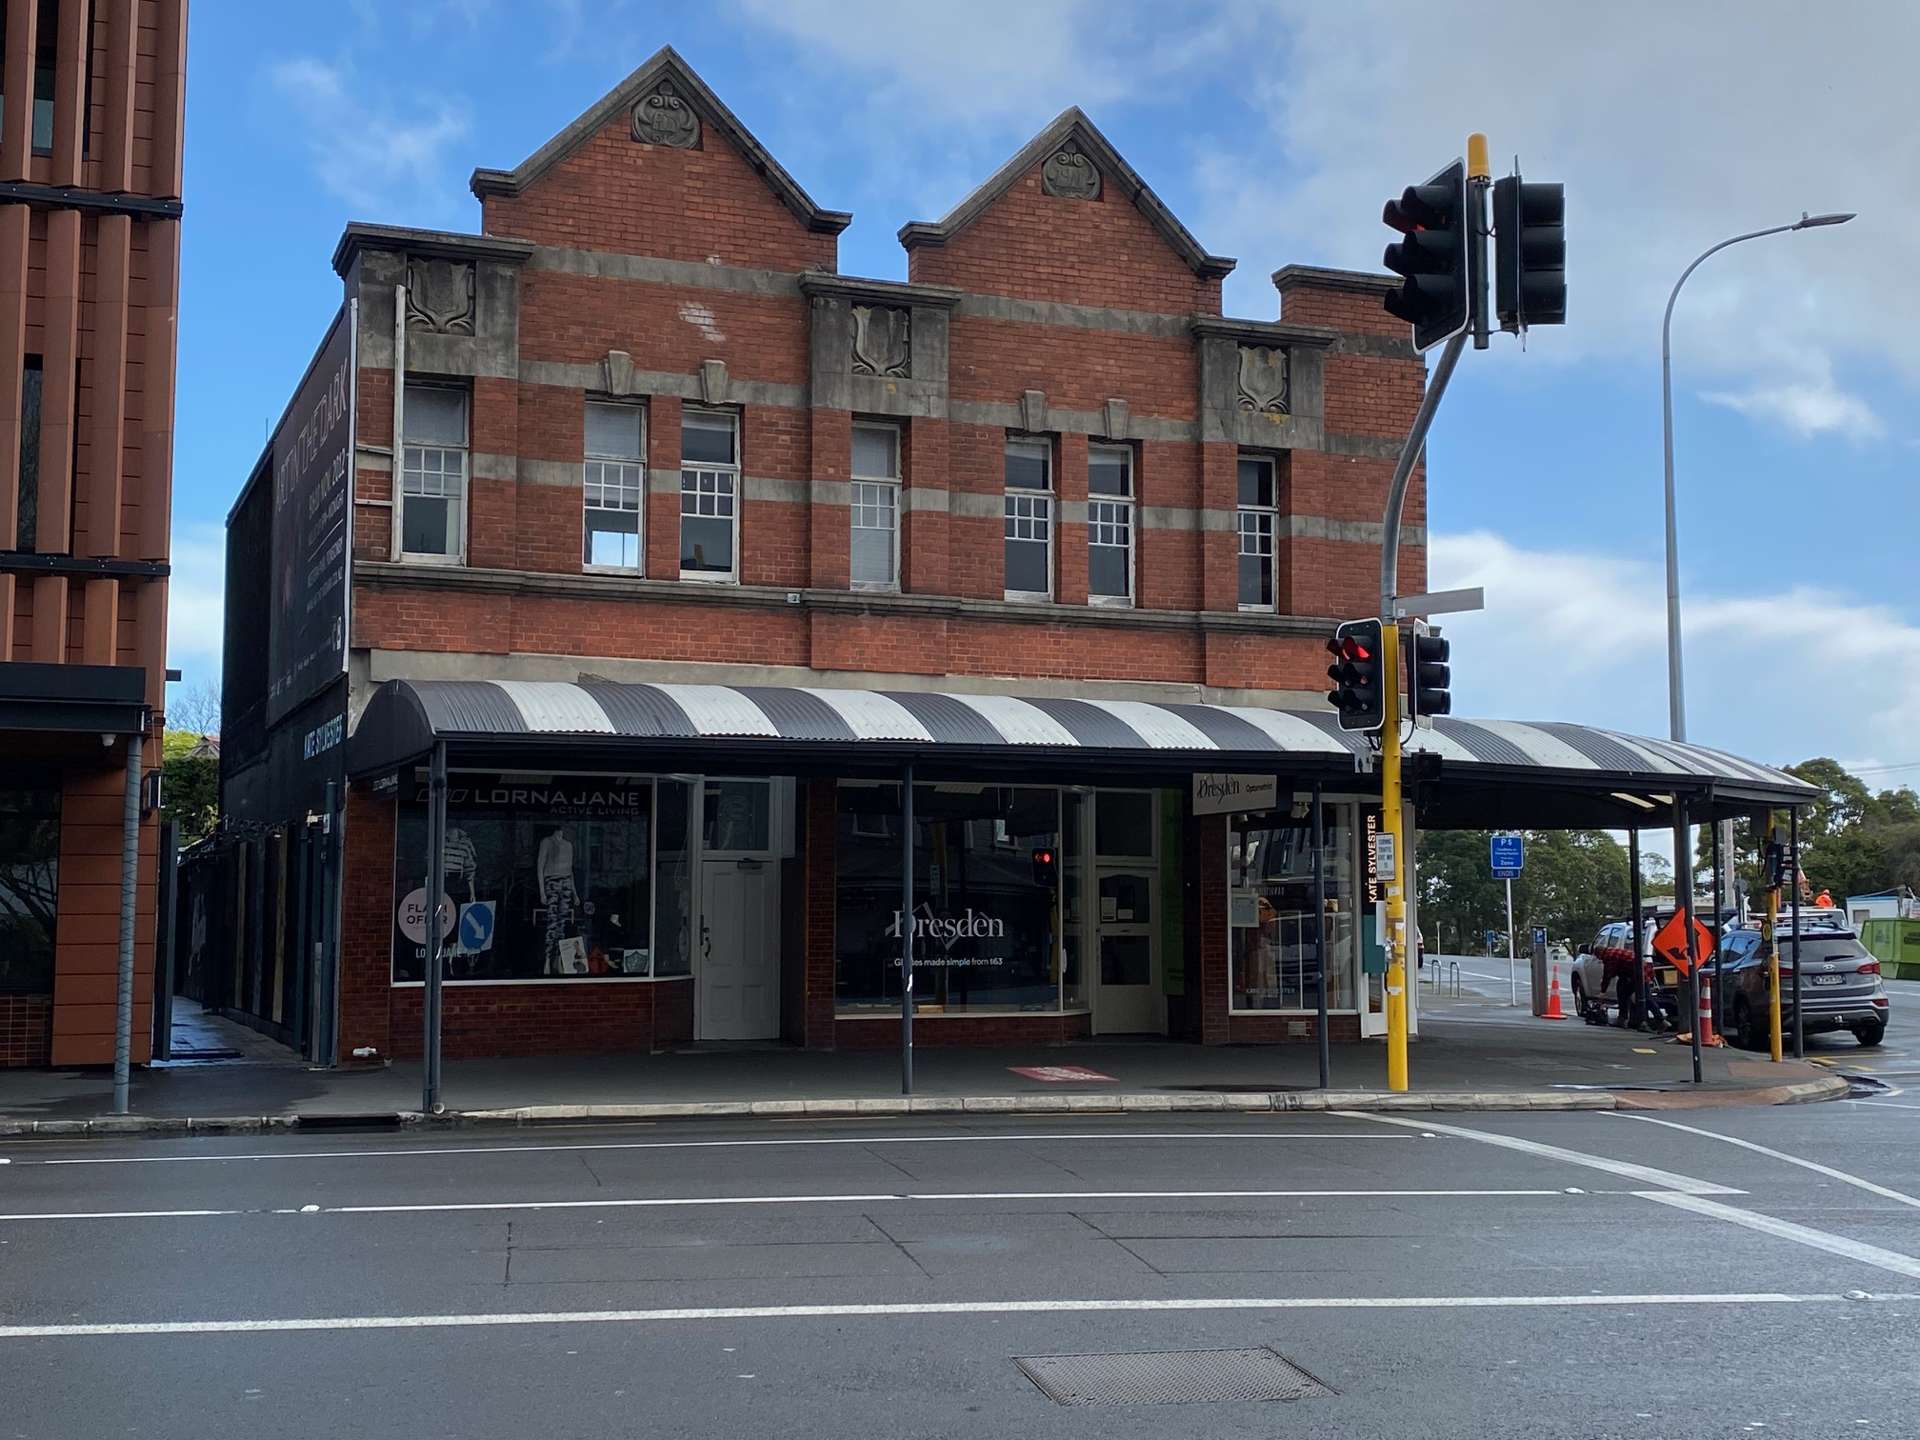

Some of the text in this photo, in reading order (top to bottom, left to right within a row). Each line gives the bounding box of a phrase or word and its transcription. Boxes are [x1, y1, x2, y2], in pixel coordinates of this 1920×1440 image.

[474, 789, 640, 806] LORNA JANE
[549, 806, 640, 817] ACTIVE LIVING
[1367, 815, 1377, 904] KATE SYLVESTER
[892, 907, 1004, 938] Dresden
[923, 957, 946, 967] made
[945, 957, 971, 969] simple
[971, 957, 989, 966] from
